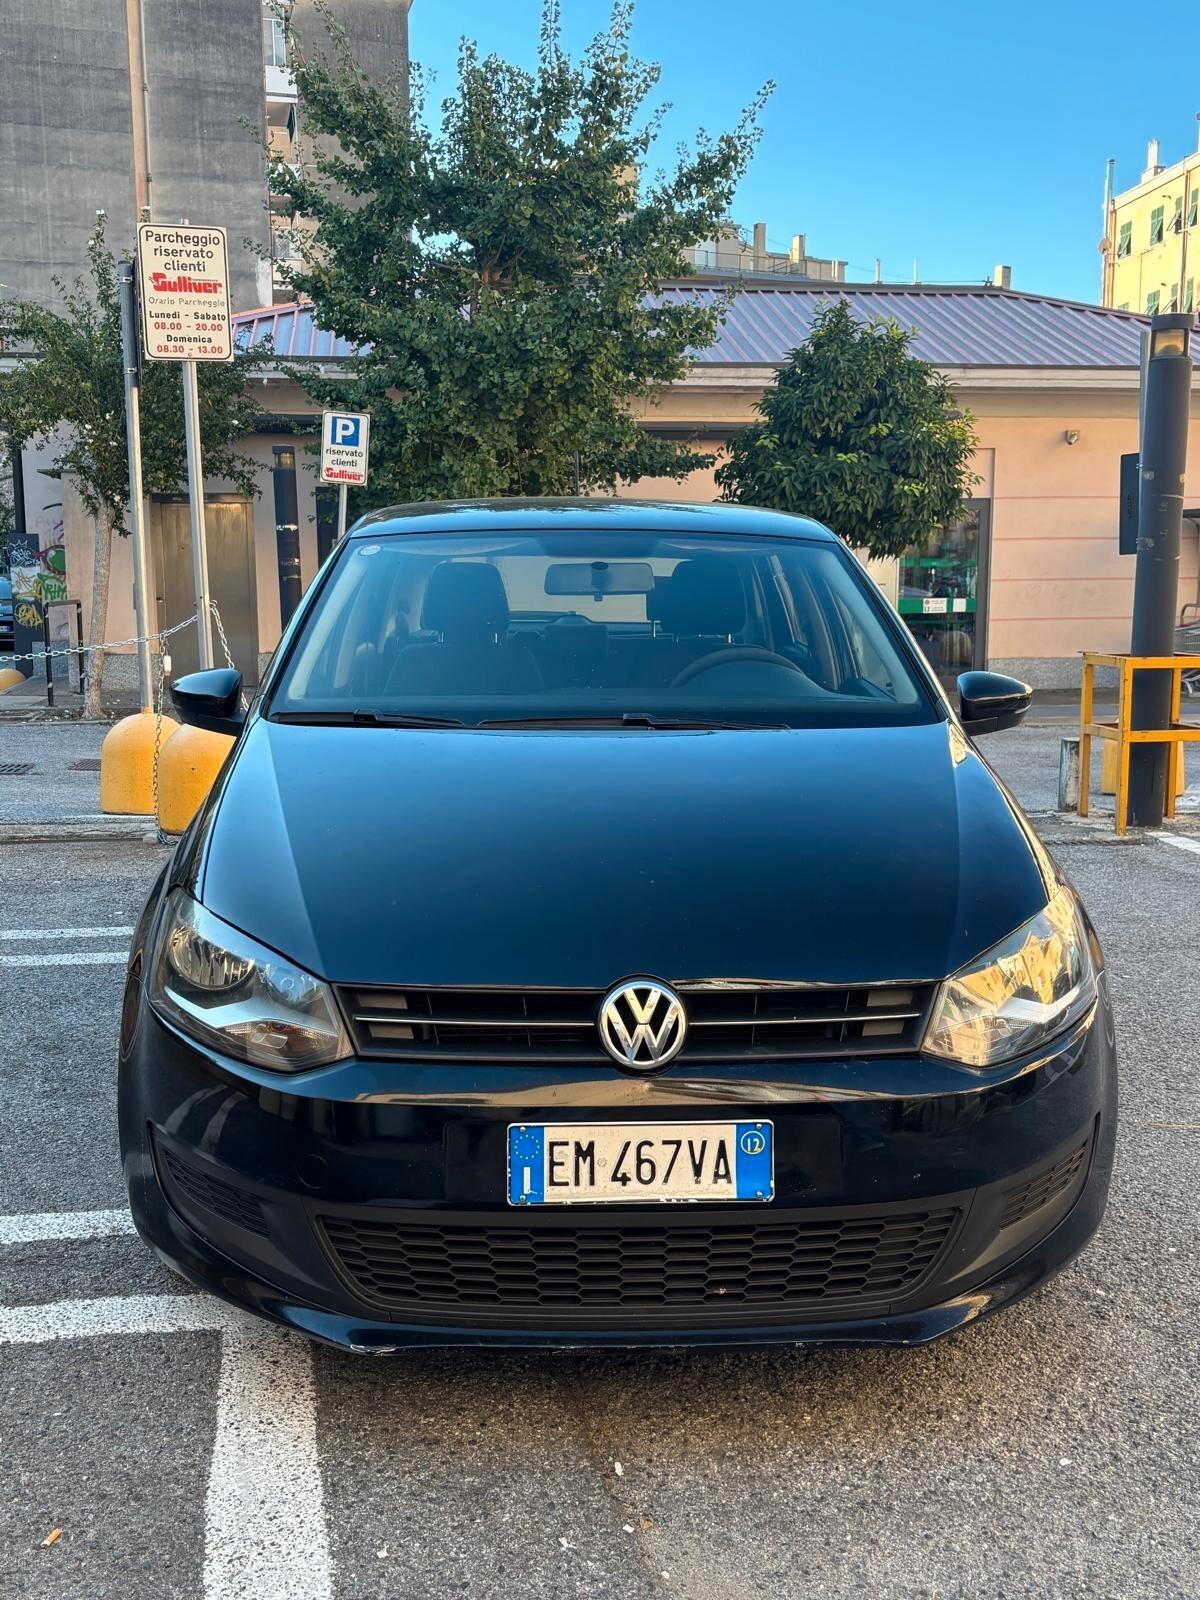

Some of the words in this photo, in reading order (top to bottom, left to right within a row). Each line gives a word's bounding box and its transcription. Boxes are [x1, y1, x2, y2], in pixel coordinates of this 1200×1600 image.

[145, 230, 221, 247] Parcheggio
[153, 246, 214, 259] riservato
[164, 260, 206, 272] clienti
[151, 272, 223, 294] Gulliver
[148, 296, 175, 305] Orario
[179, 298, 225, 308] Parcheggio
[149, 310, 181, 319] Lunedi
[193, 311, 226, 321] Sabato
[154, 321, 182, 331] 08.00
[195, 323, 223, 332] 20.00
[166, 334, 212, 343] Domenica
[156, 344, 185, 353] 08.30
[197, 345, 223, 354] 13.00
[335, 418, 355, 444] P
[325, 447, 363, 458] riservato
[331, 458, 358, 467] clienti
[325, 467, 364, 480] Gulliver
[747, 1137, 761, 1152] 12
